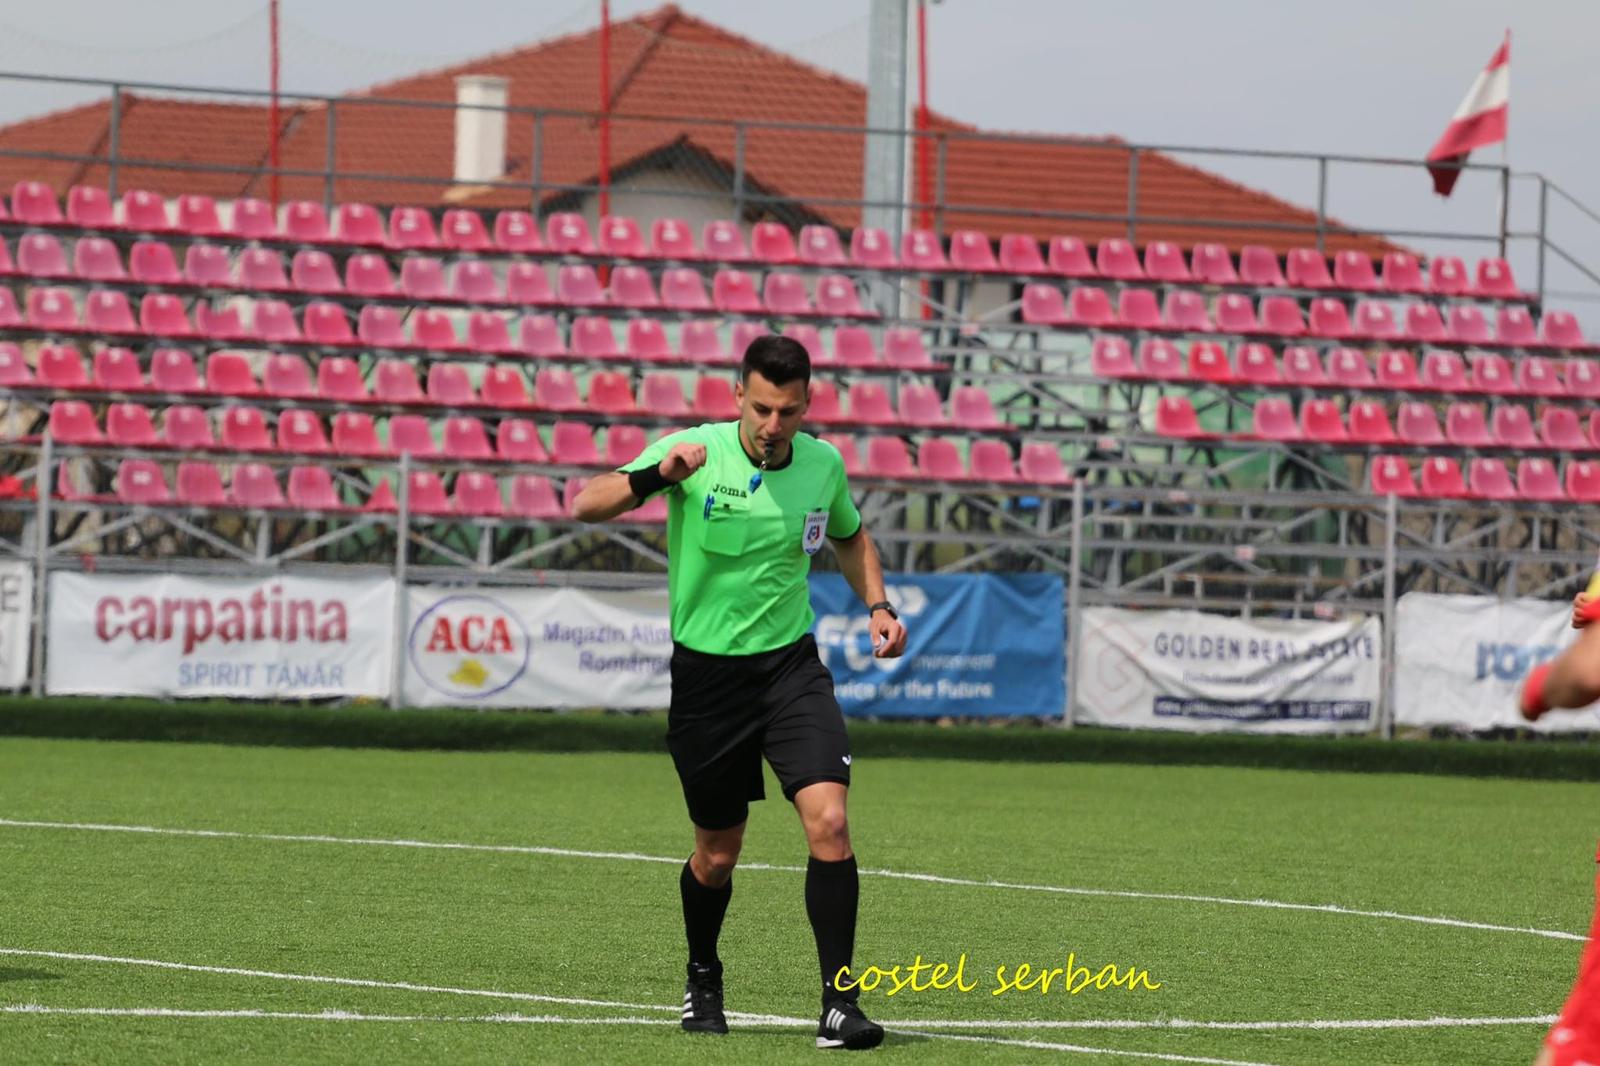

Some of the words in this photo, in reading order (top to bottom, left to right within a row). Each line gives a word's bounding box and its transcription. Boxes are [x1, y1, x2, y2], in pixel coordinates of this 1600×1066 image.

[94, 585, 348, 655] carpatina
[426, 616, 514, 653] ACA
[543, 621, 625, 647] Magazin
[1155, 632, 1241, 660] GOLDEN
[178, 662, 255, 688] SPIRIT
[904, 679, 935, 699] the
[937, 678, 993, 700] Future
